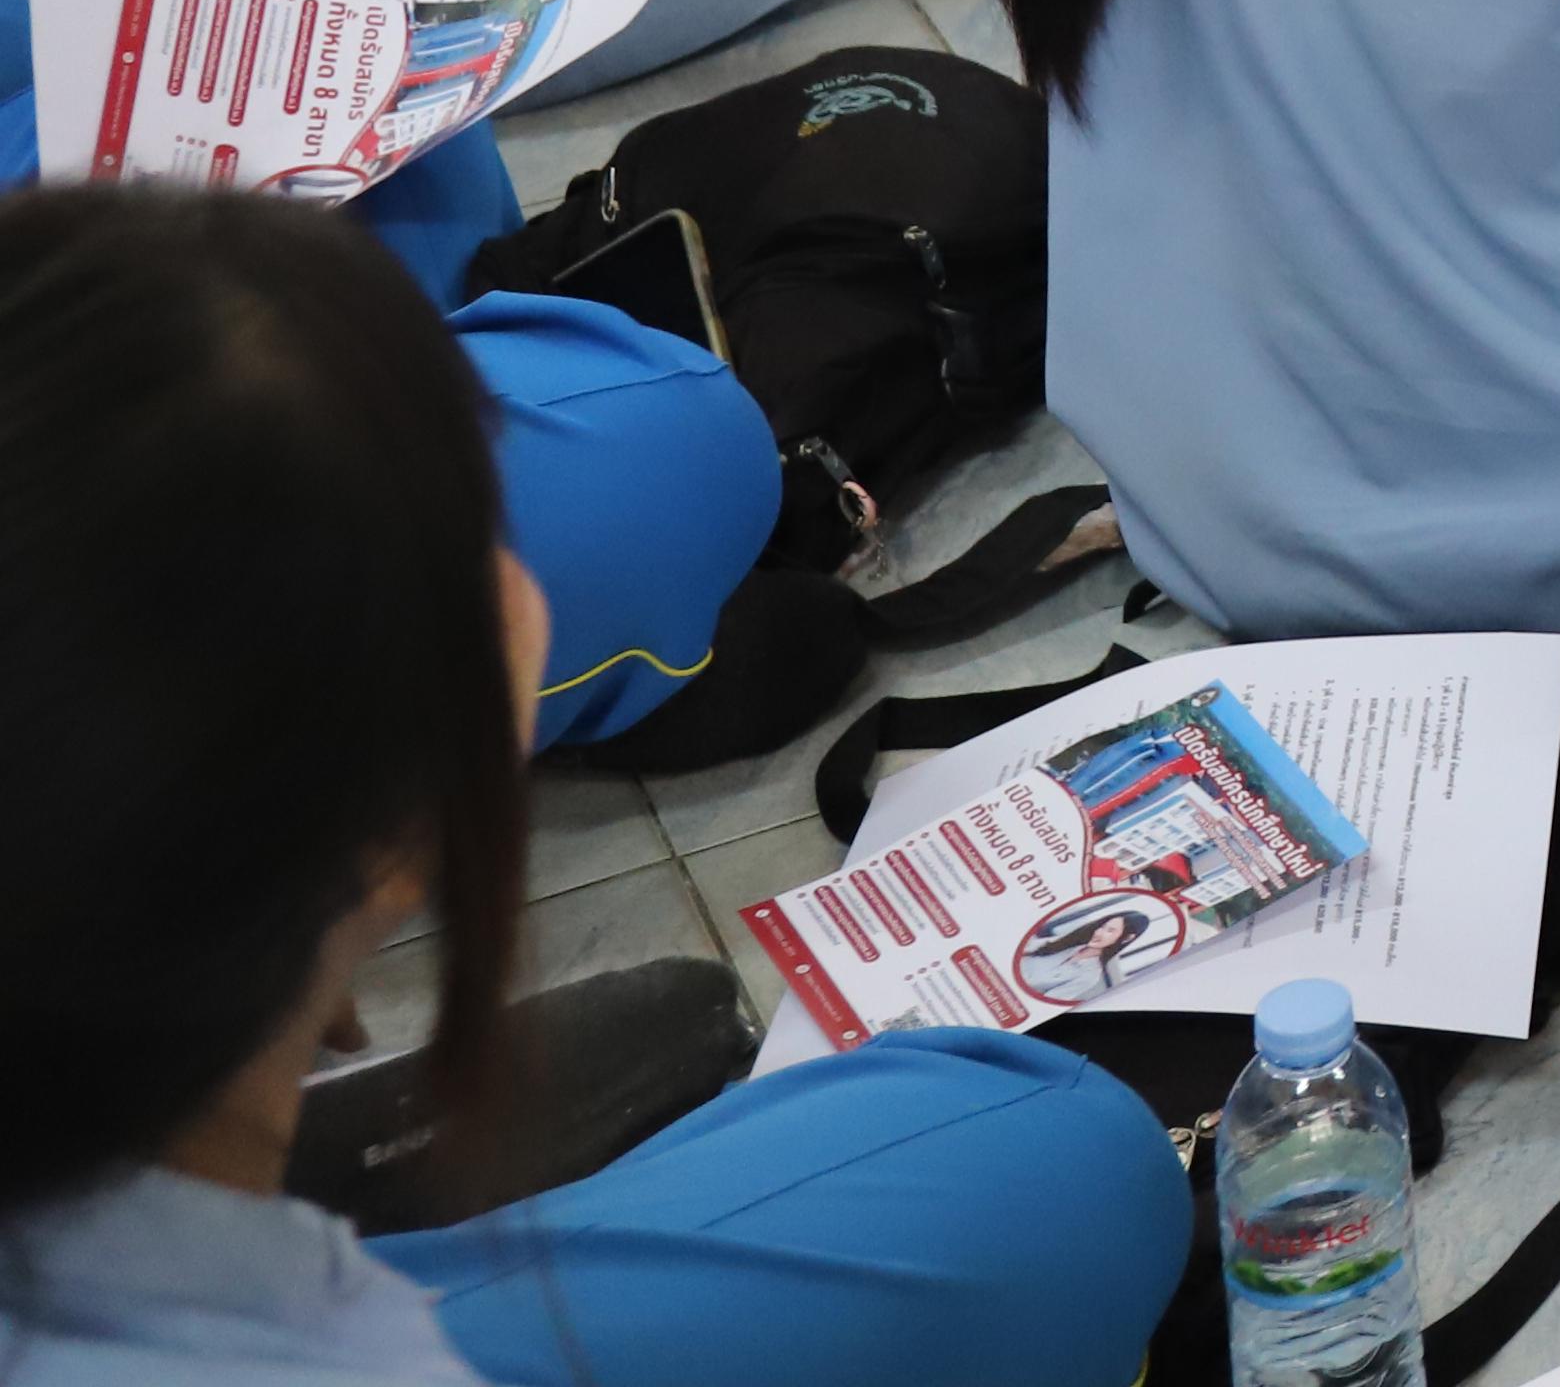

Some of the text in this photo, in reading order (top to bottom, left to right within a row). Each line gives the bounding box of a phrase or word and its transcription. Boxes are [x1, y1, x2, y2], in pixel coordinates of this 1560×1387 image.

[302, 1, 358, 158] ทั้งหมด 8 สาขา
[347, 5, 387, 121] เปิดรับสมัคร
[965, 799, 1057, 910] ทั้งหมด 8 สาขา
[1003, 782, 1076, 865] เปิดรับสมัคร
[1174, 724, 1317, 880] เปิดรับสมัครนักศึกษาใหม่
